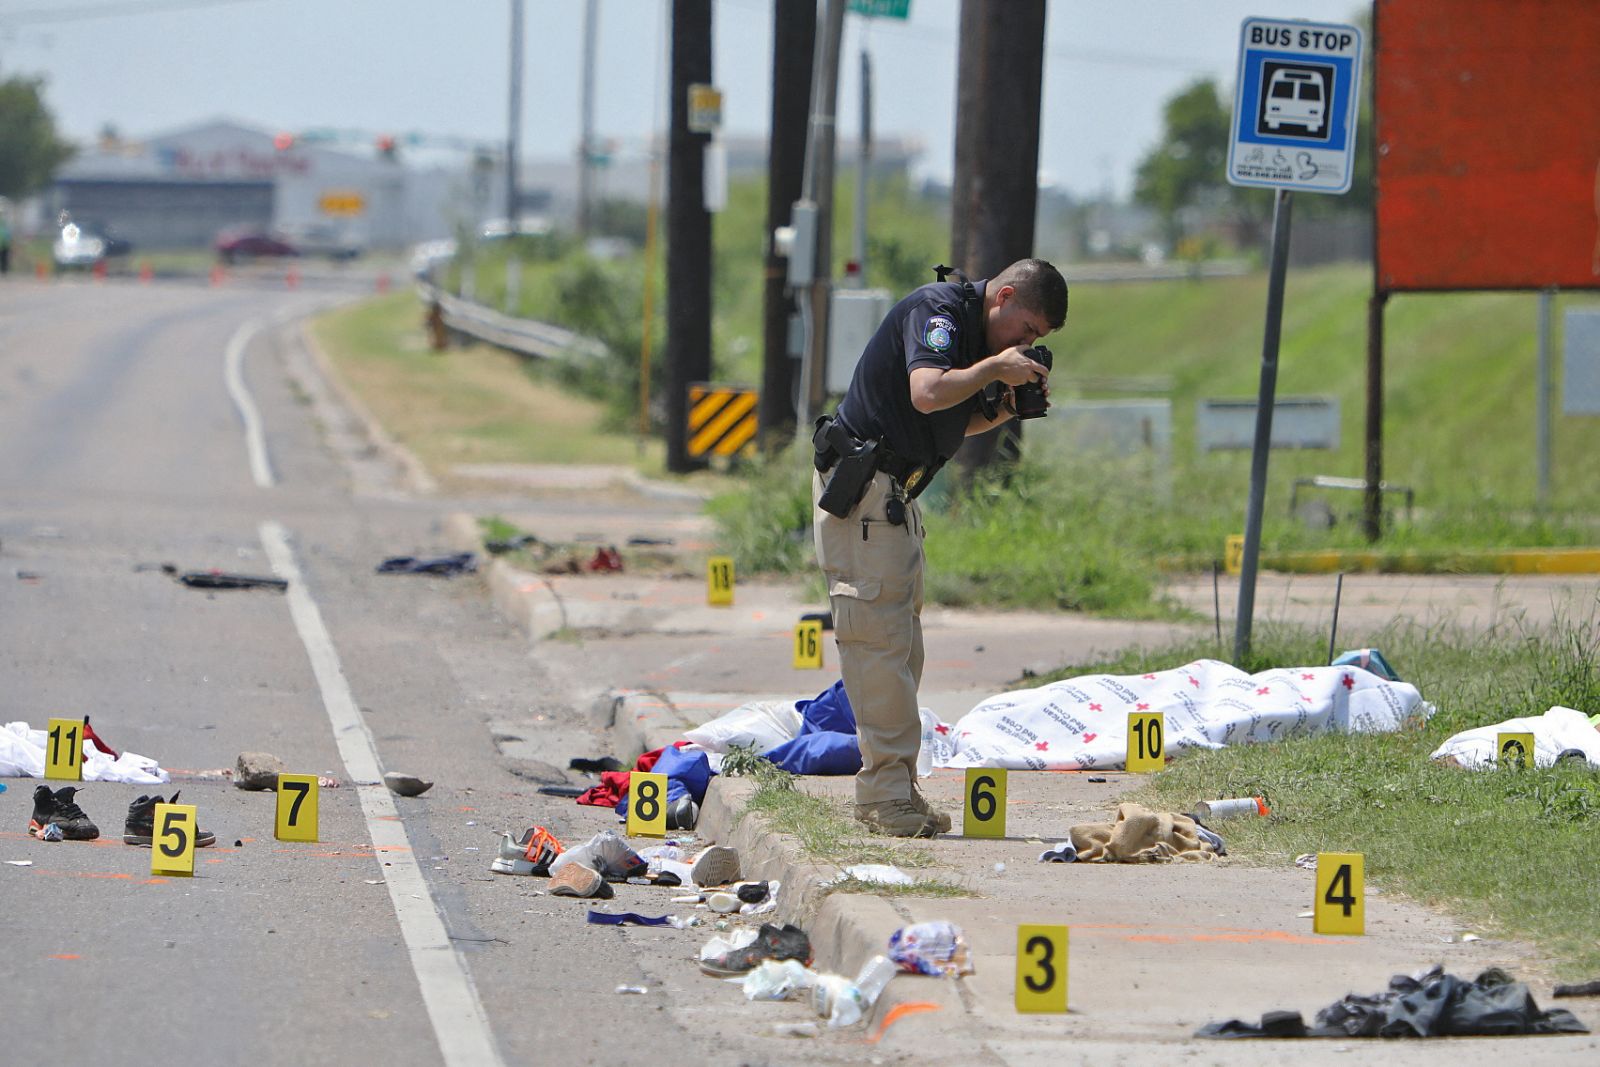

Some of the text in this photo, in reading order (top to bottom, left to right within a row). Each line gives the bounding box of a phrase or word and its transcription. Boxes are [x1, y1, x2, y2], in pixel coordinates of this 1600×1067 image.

[1251, 27, 1351, 51] BUS STOP
[798, 627, 817, 658] 16
[996, 722, 1032, 746] American
[1001, 715, 1039, 741] Red Cross
[1042, 706, 1081, 736] American
[1049, 702, 1087, 732] Red Cross
[50, 725, 77, 767] 11
[1132, 718, 1162, 760] 10
[282, 782, 310, 826] 7
[634, 780, 660, 822] 8
[970, 775, 997, 822] 6
[159, 812, 187, 857] 5
[1325, 864, 1356, 917] 4
[1023, 936, 1057, 994] 3
